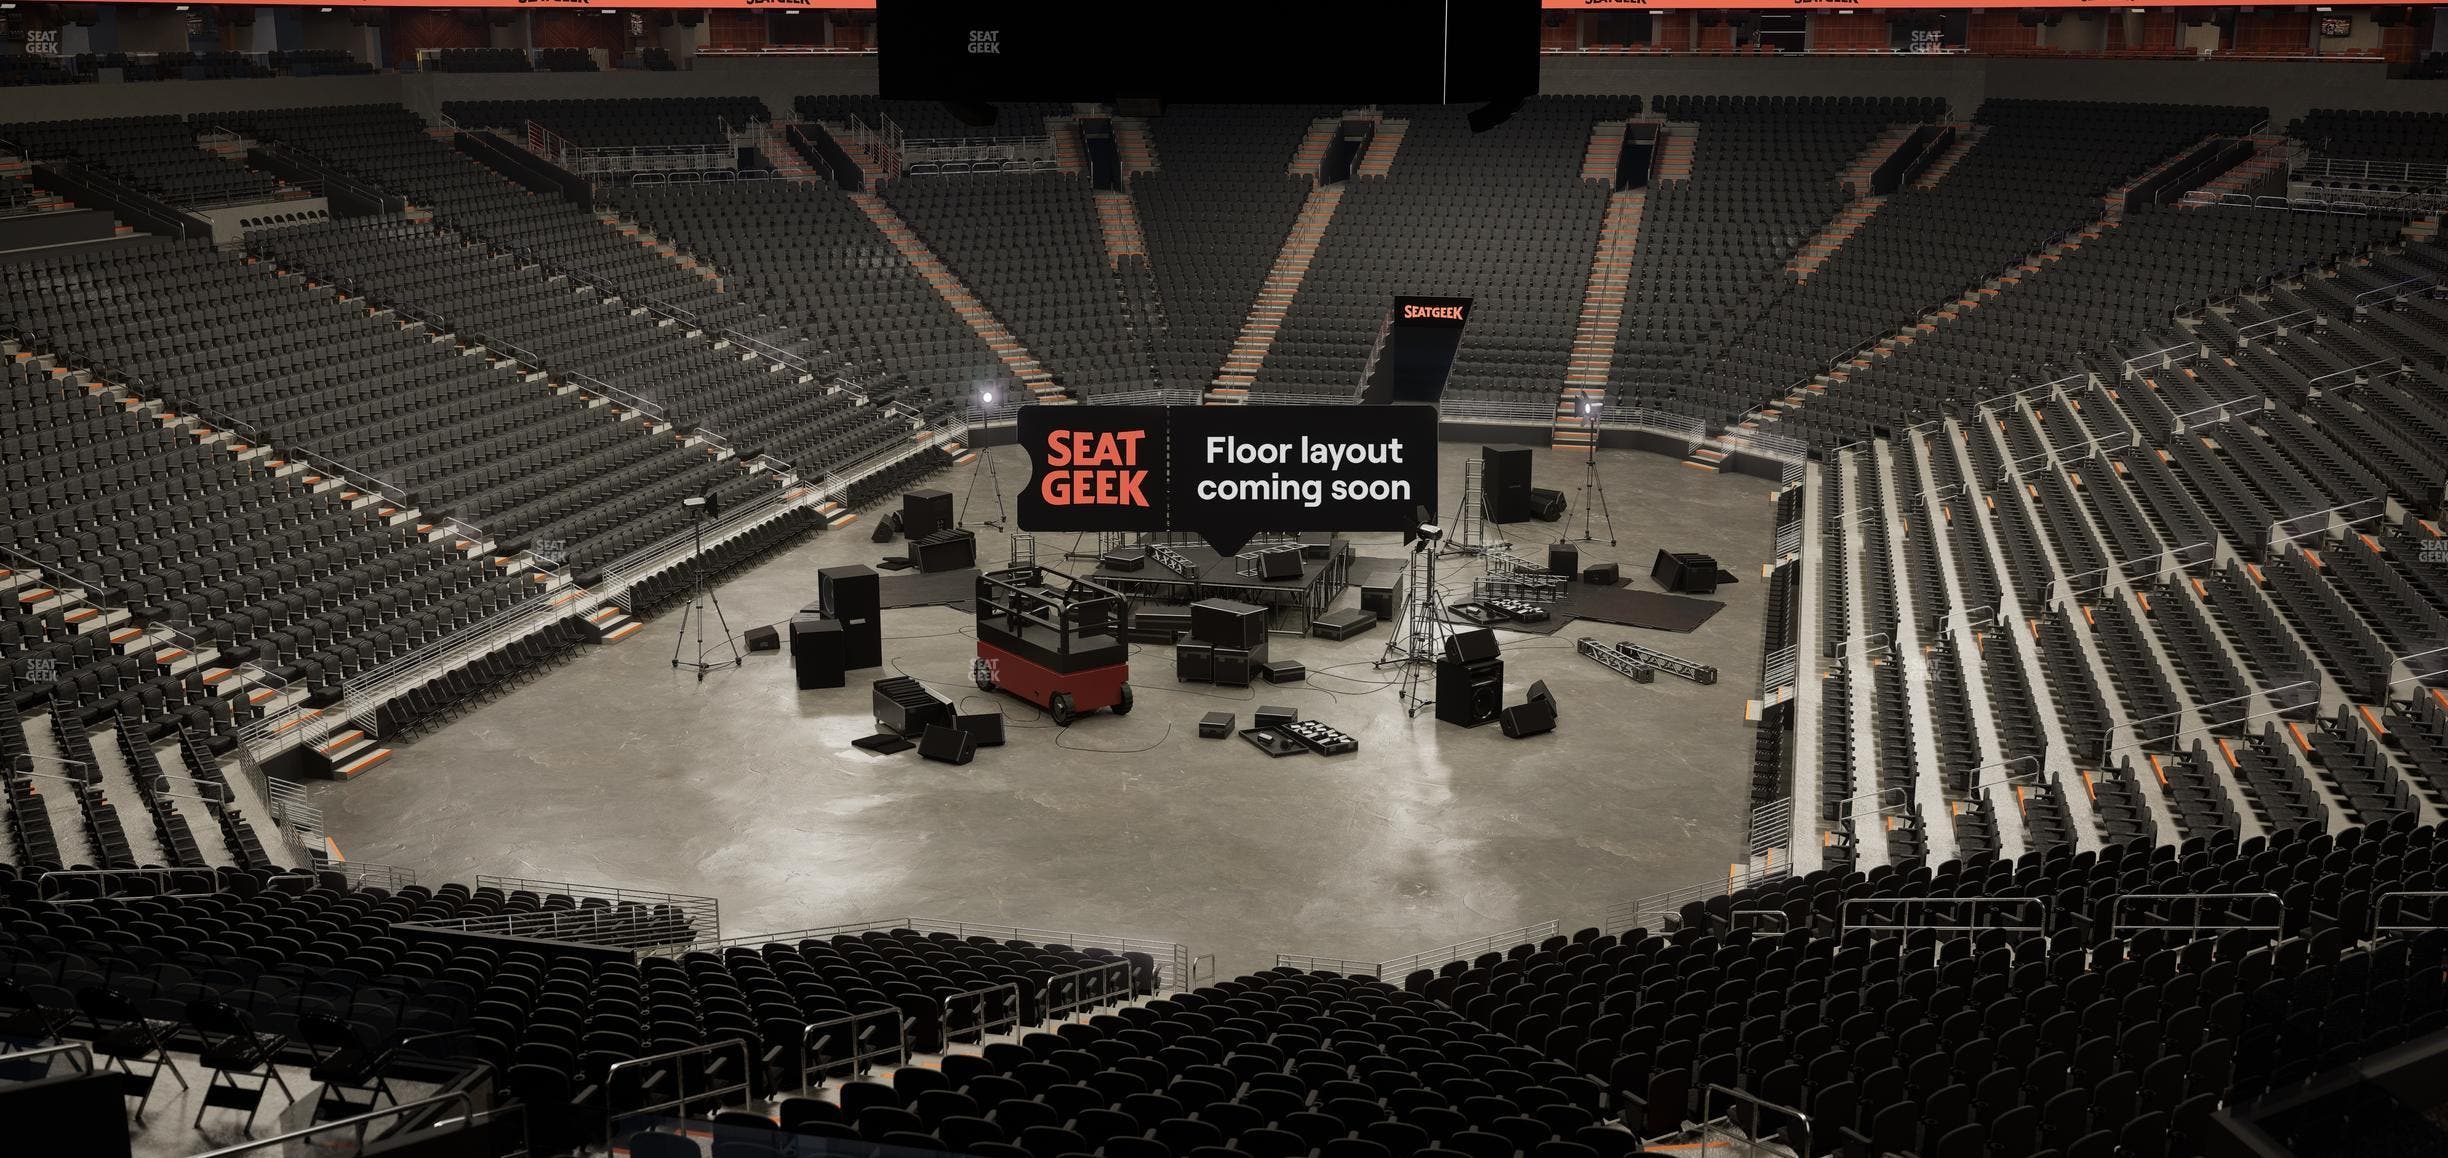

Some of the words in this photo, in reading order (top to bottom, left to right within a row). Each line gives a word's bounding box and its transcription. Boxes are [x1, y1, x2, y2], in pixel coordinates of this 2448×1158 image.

[1404, 304, 1463, 320] SEATGEEK
[1047, 429, 1146, 467] SEAT
[1207, 435, 1293, 464] Floor
[1301, 435, 1403, 471] layout
[1041, 470, 1150, 507] GEEK
[1197, 472, 1322, 508] coming
[1331, 479, 1411, 501] soon
